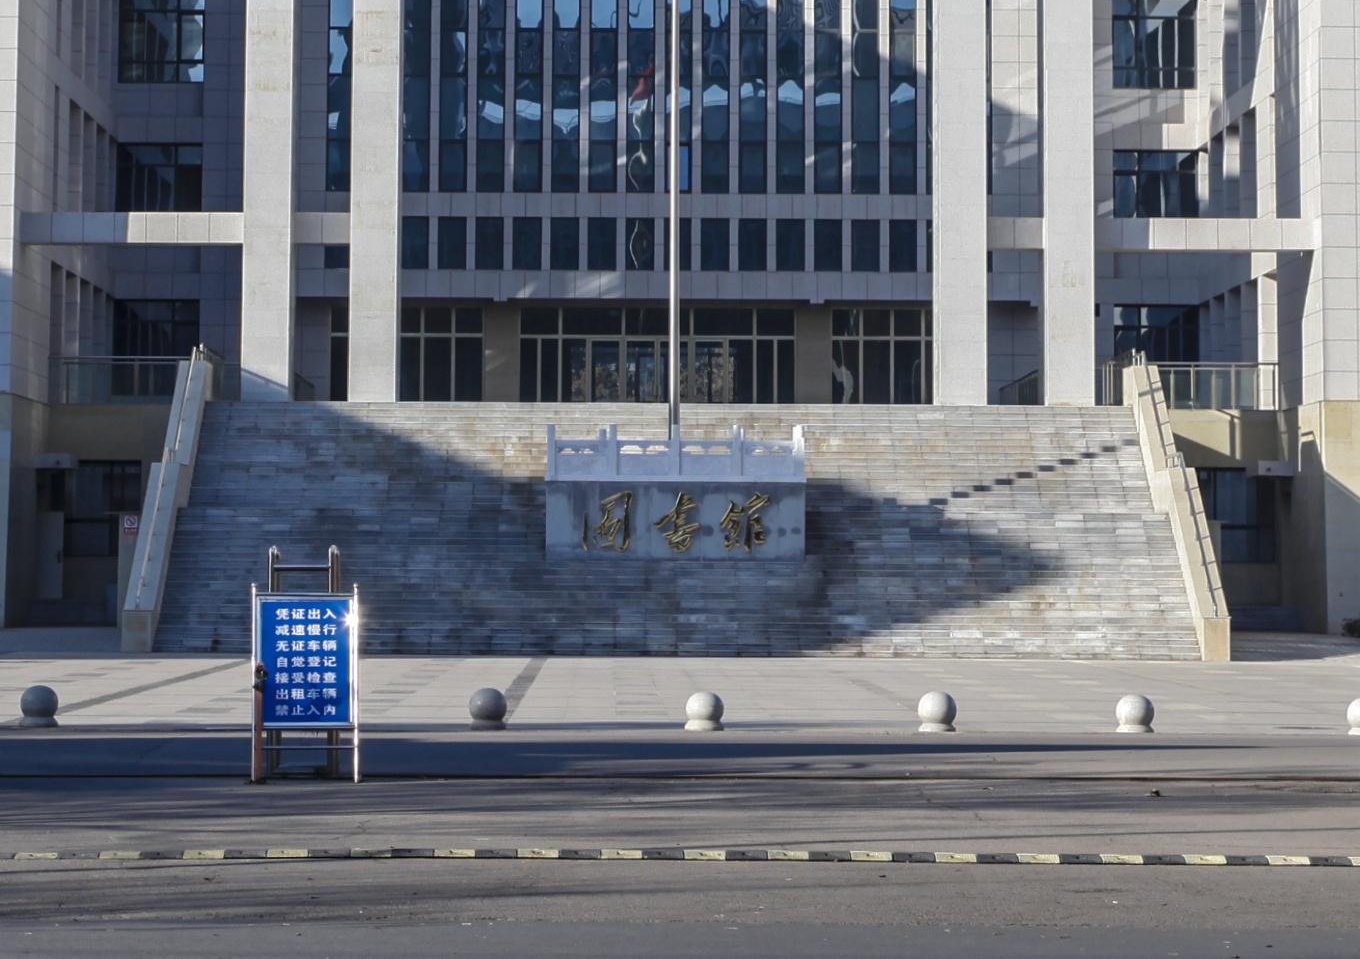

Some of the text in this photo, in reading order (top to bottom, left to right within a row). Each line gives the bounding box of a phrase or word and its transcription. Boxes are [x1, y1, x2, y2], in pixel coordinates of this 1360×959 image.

[275, 608, 337, 620] 凭证出入
[275, 624, 337, 636] 减速慢行
[275, 640, 337, 652] 无证车辆
[276, 656, 337, 668] 自觉登记
[275, 672, 337, 684] 接受检查
[275, 688, 337, 700] 出租车辆
[275, 704, 336, 716] 禁止入内
